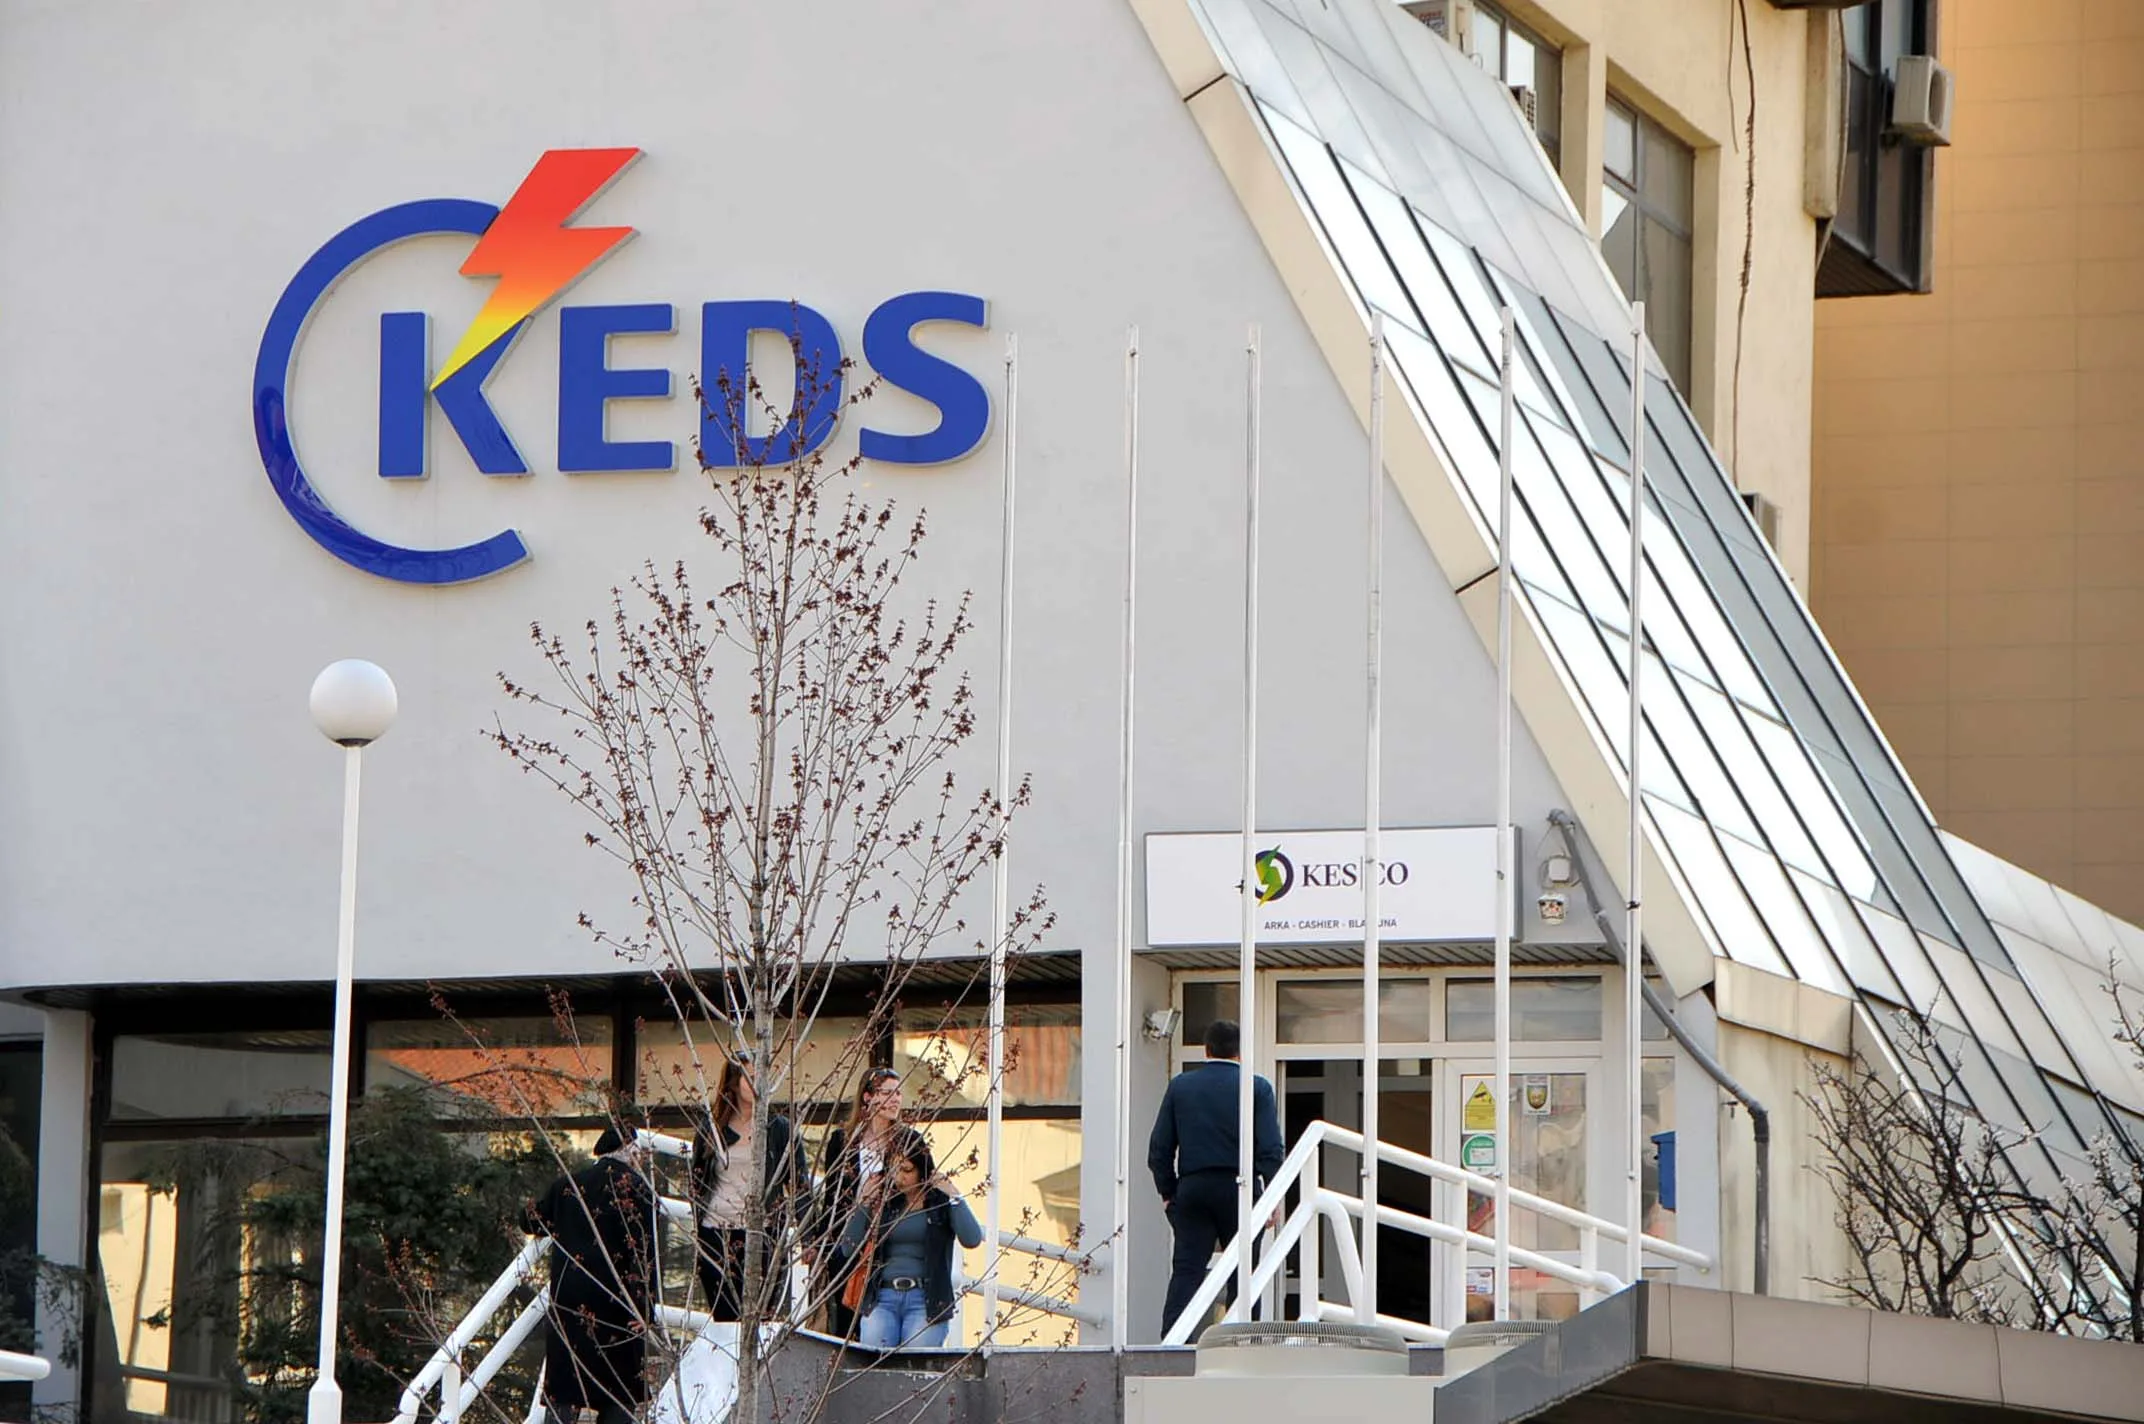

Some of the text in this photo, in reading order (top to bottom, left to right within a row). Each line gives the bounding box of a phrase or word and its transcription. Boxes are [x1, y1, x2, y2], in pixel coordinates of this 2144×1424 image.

[378, 290, 991, 480] KEDS
[1264, 921, 1290, 930] ARKA
[1298, 919, 1340, 930] CASHIER
[1348, 918, 1398, 929] BLAJNA
